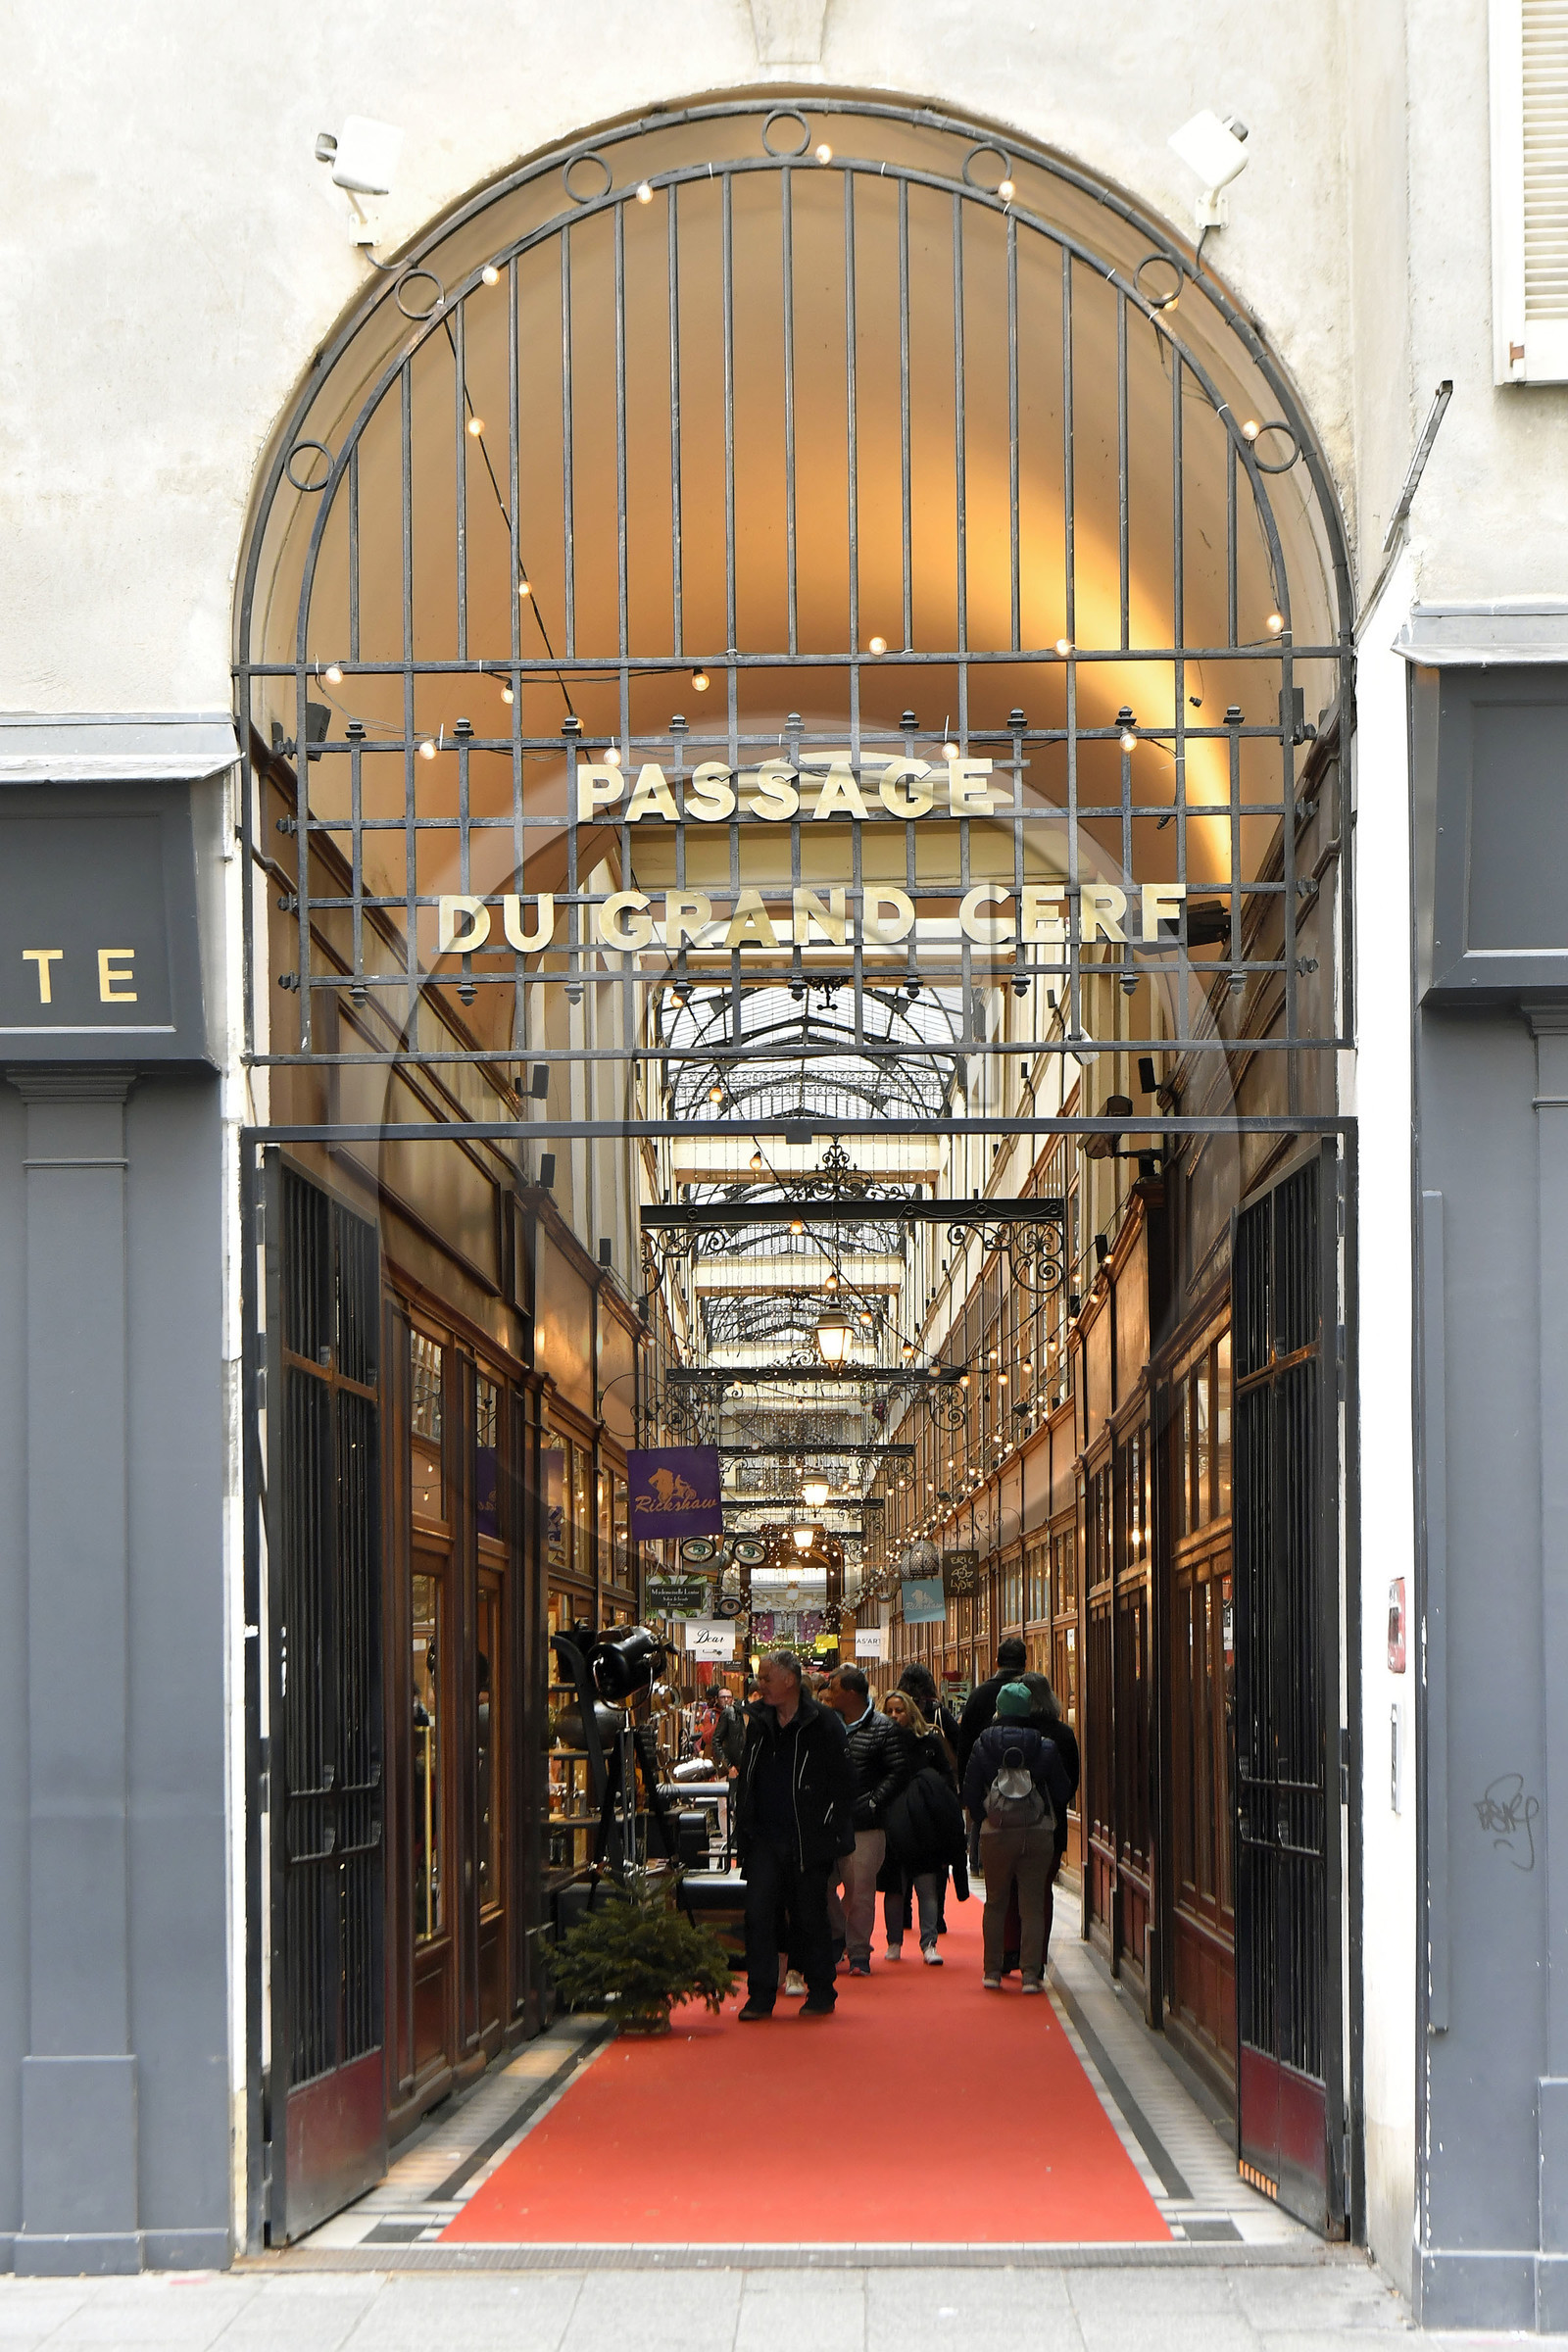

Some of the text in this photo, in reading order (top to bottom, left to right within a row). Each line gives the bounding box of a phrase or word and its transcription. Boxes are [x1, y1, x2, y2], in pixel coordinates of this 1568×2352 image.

[575, 758, 996, 823] PASSAGE
[437, 883, 1189, 955] DU GRAND CERF
[634, 1494, 718, 1513] Rickshaw
[694, 1629, 725, 1643] Dear
